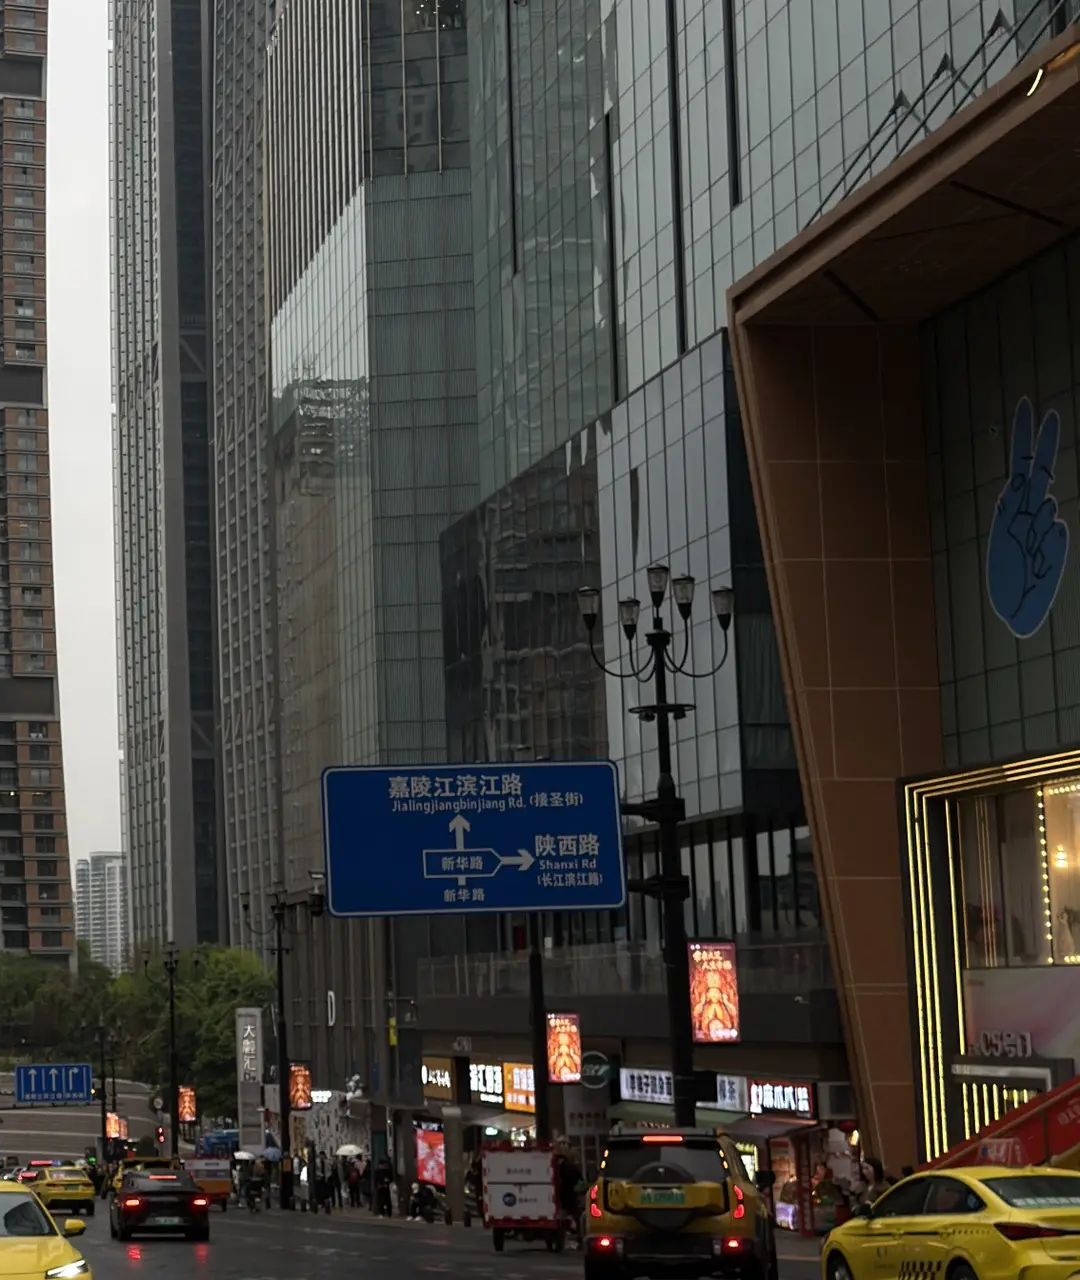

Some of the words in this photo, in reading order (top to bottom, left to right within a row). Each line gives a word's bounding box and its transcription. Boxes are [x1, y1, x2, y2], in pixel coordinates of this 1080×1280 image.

[388, 773, 523, 799] 嘉陵江滨江路
[392, 797, 506, 814] Jialingjiangbinjiang
[534, 833, 600, 857] 陕西路
[441, 855, 484, 871] 新华路
[539, 859, 578, 870] Shanxi
[582, 859, 597, 869] Rd
[443, 888, 485, 903] 新华路
